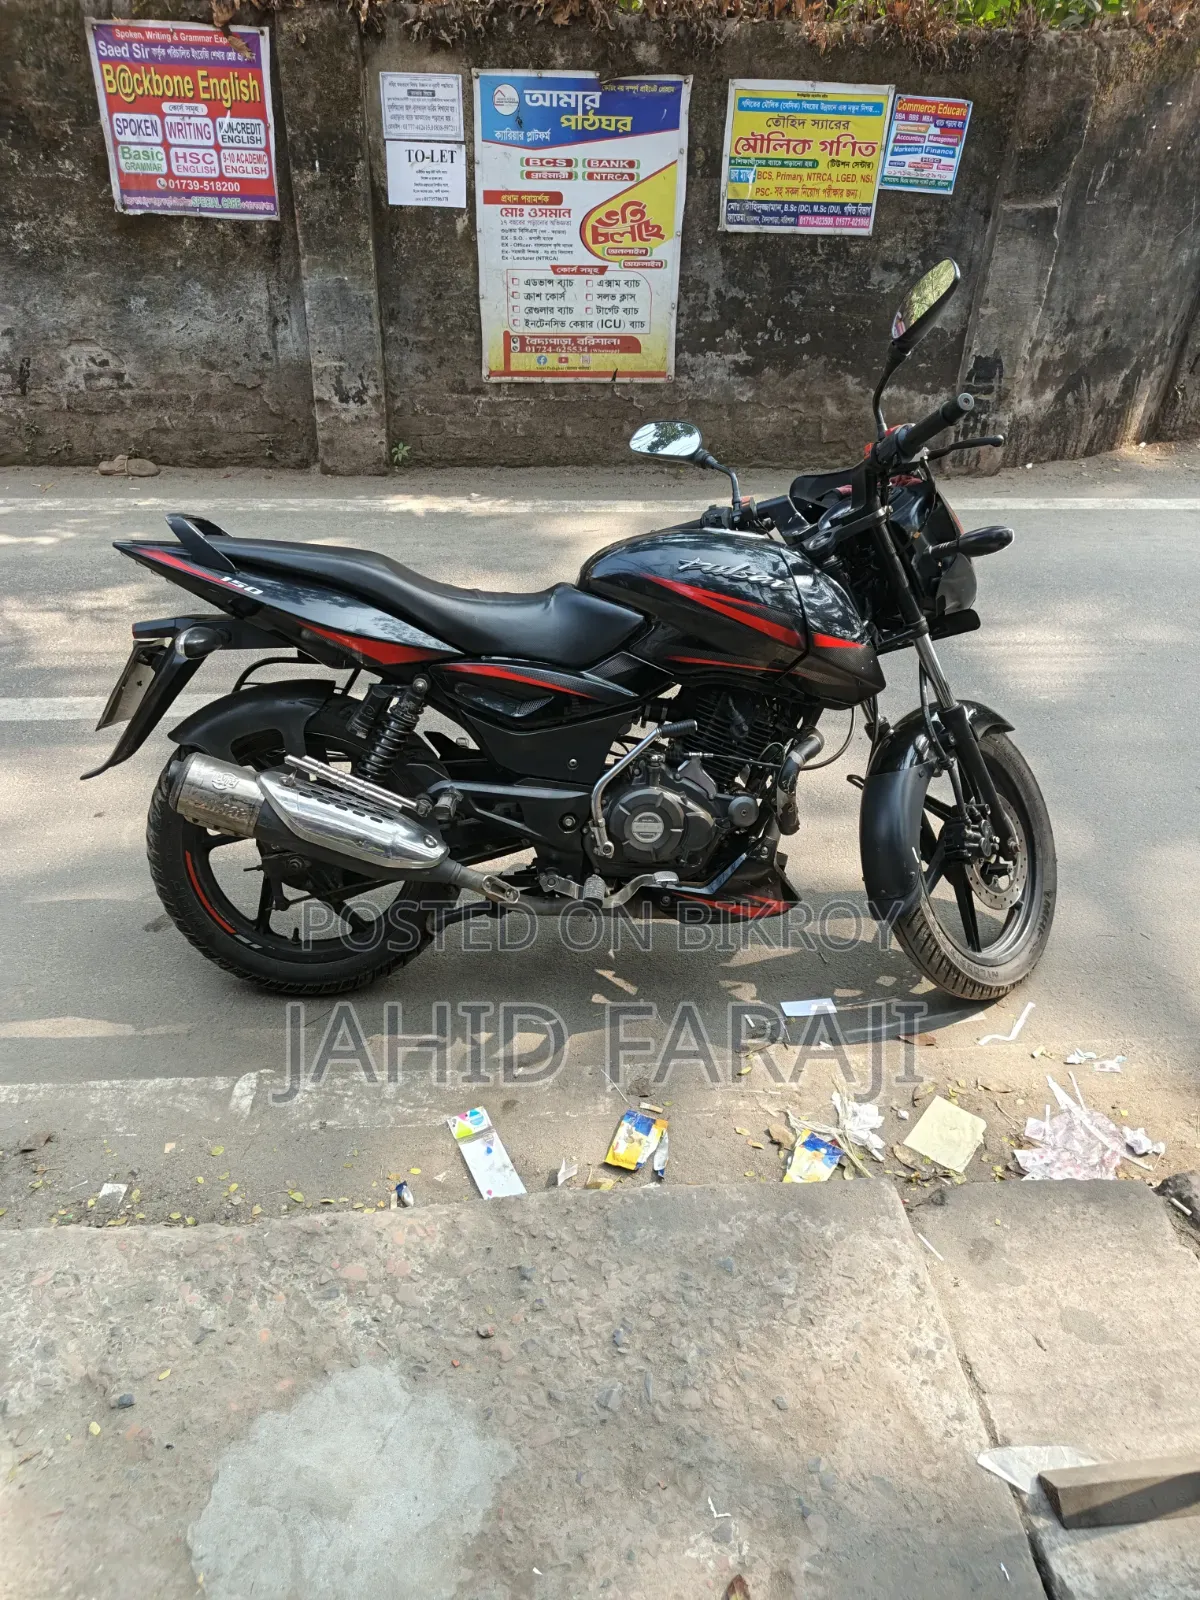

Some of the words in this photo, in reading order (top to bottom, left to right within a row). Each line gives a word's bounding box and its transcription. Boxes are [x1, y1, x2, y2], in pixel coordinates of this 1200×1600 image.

[115, 29, 144, 40] Spoken,
[145, 31, 171, 42] Writing
[180, 33, 212, 42] Grammar
[98, 41, 129, 57] Saed
[132, 43, 150, 59] Sir
[102, 63, 194, 103] B@ckbone
[197, 69, 261, 109] English
[524, 90, 602, 112] আমার
[897, 100, 936, 114] Commerce
[938, 103, 968, 116] Educare
[560, 109, 633, 133] পাঠঘর
[766, 114, 807, 130] তৌহিদ
[811, 118, 851, 130] স্যারের
[116, 118, 158, 137] SPOKEN
[166, 121, 212, 140] WRITING
[222, 135, 262, 145] ENGLISH
[494, 128, 524, 141] ক্যারিয়ার
[896, 134, 924, 142] Accounting
[929, 135, 958, 144] Management
[734, 131, 813, 156] মৌলিক
[819, 134, 878, 157] গণিত
[121, 146, 164, 162] Basic
[894, 146, 922, 154] Marketing
[925, 147, 954, 155] Finance
[175, 152, 214, 165] HSC
[236, 154, 268, 165] ACADEMIC
[405, 149, 457, 164] TO-LET
[125, 162, 163, 172] GRAMMAR
[529, 158, 567, 167] BCS
[590, 160, 629, 168] BANK
[827, 159, 850, 169] (টিউশন
[852, 161, 874, 170] সেন্টার)
[176, 165, 217, 175] ENGLISH
[225, 165, 267, 176] ENGLISH
[593, 173, 629, 181] NTRCA
[757, 171, 774, 181] BCS,
[776, 171, 804, 183] Primary,
[806, 173, 834, 183] NTRCA,
[836, 174, 858, 184] LGED,
[861, 175, 874, 184] NSI,
[168, 179, 241, 192] 01739-518200
[755, 188, 773, 196] PSC-
[501, 194, 519, 203] প্রধান
[521, 193, 550, 203] পরামর্শক
[500, 207, 524, 218] মোঃ
[528, 207, 572, 218] ওসমান
[595, 200, 647, 228] ভর্তি
[591, 218, 666, 245] চলছে
[624, 260, 662, 268] অফলাইন
[556, 266, 578, 274] কোর্স
[580, 267, 600, 275] সমূহ
[557, 278, 574, 288] ব্যাচ
[597, 279, 621, 288] এক্সাম
[624, 280, 641, 288] ব্যাচ
[524, 291, 542, 301] ক্রাশ
[545, 291, 566, 301] কোর্স
[597, 293, 616, 301] সলভ
[619, 293, 636, 302] ক্লাস
[524, 306, 554, 316] রেগুলার
[557, 306, 574, 315] ব্যাচ
[596, 305, 619, 316] টার্গেট
[622, 307, 639, 316] ব্যাচ
[524, 318, 566, 329] ইনটেনসিভ
[569, 320, 593, 329] কেয়ার
[597, 319, 626, 329] (ICU)
[629, 320, 645, 329] ব্যাচ
